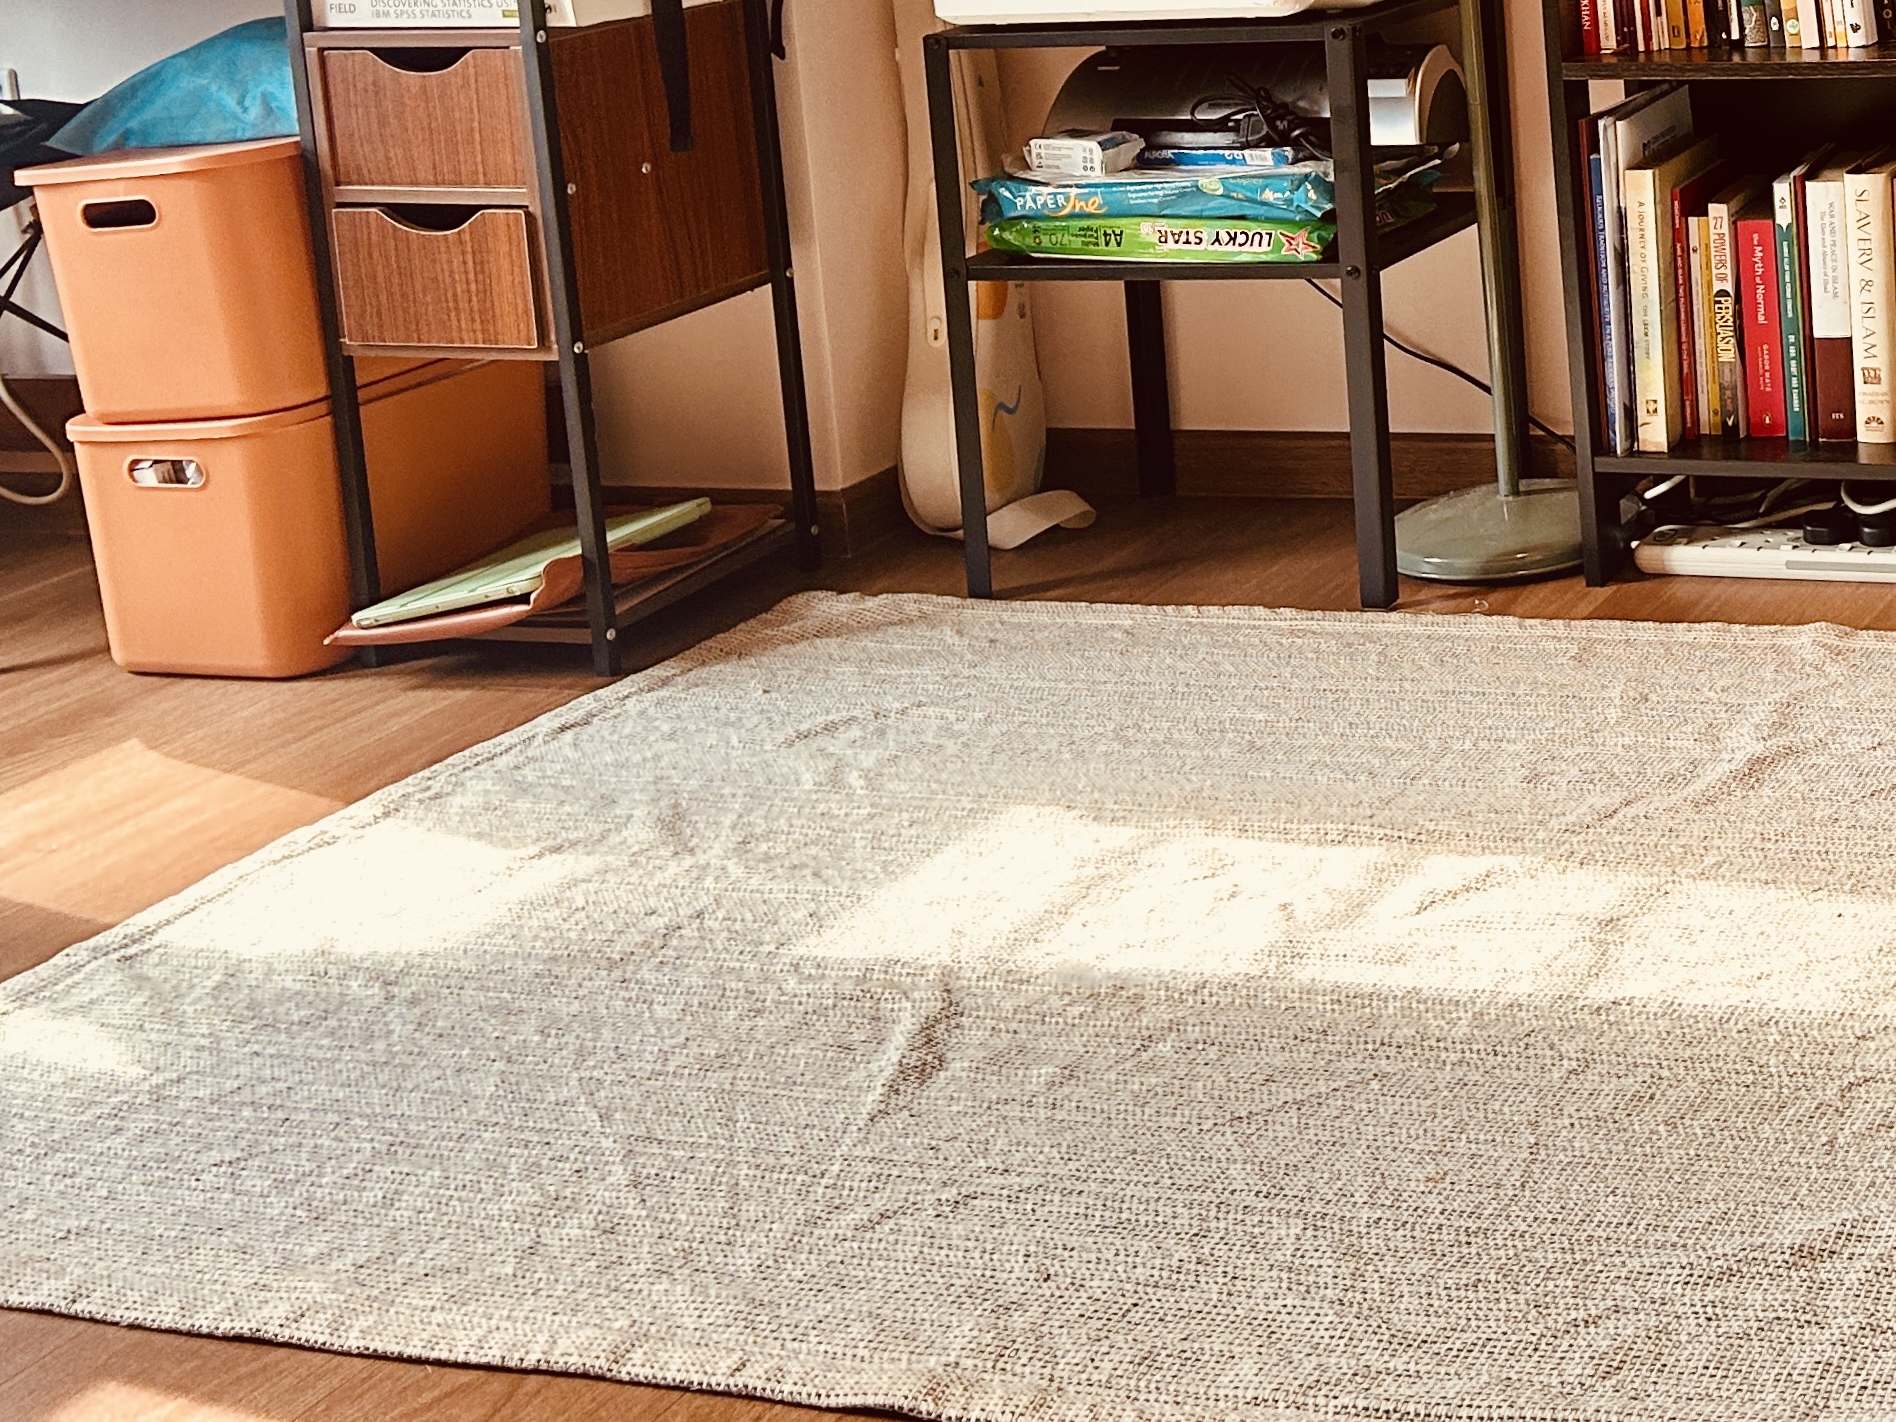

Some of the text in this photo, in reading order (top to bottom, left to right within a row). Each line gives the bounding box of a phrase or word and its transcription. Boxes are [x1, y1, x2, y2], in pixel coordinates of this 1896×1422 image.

[329, 3, 356, 14] FIELD
[371, 8, 472, 19] IBM SPSS STATISTICS
[1580, 0, 1591, 30] KHAN
[1016, 194, 1067, 210] PAPER
[1103, 229, 1124, 247] A4
[1157, 229, 1273, 247] LUCKY STAR
[1752, 233, 1760, 245] the
[1712, 232, 1728, 270] POWERS
[1752, 246, 1765, 275] Myth
[1715, 272, 1729, 284] OF
[1855, 189, 1878, 360] SLAVERY & ISLAM
[1755, 285, 1769, 324] Normal
[1714, 295, 1736, 363] PERSUASION
[1762, 344, 1770, 370] GABOR
